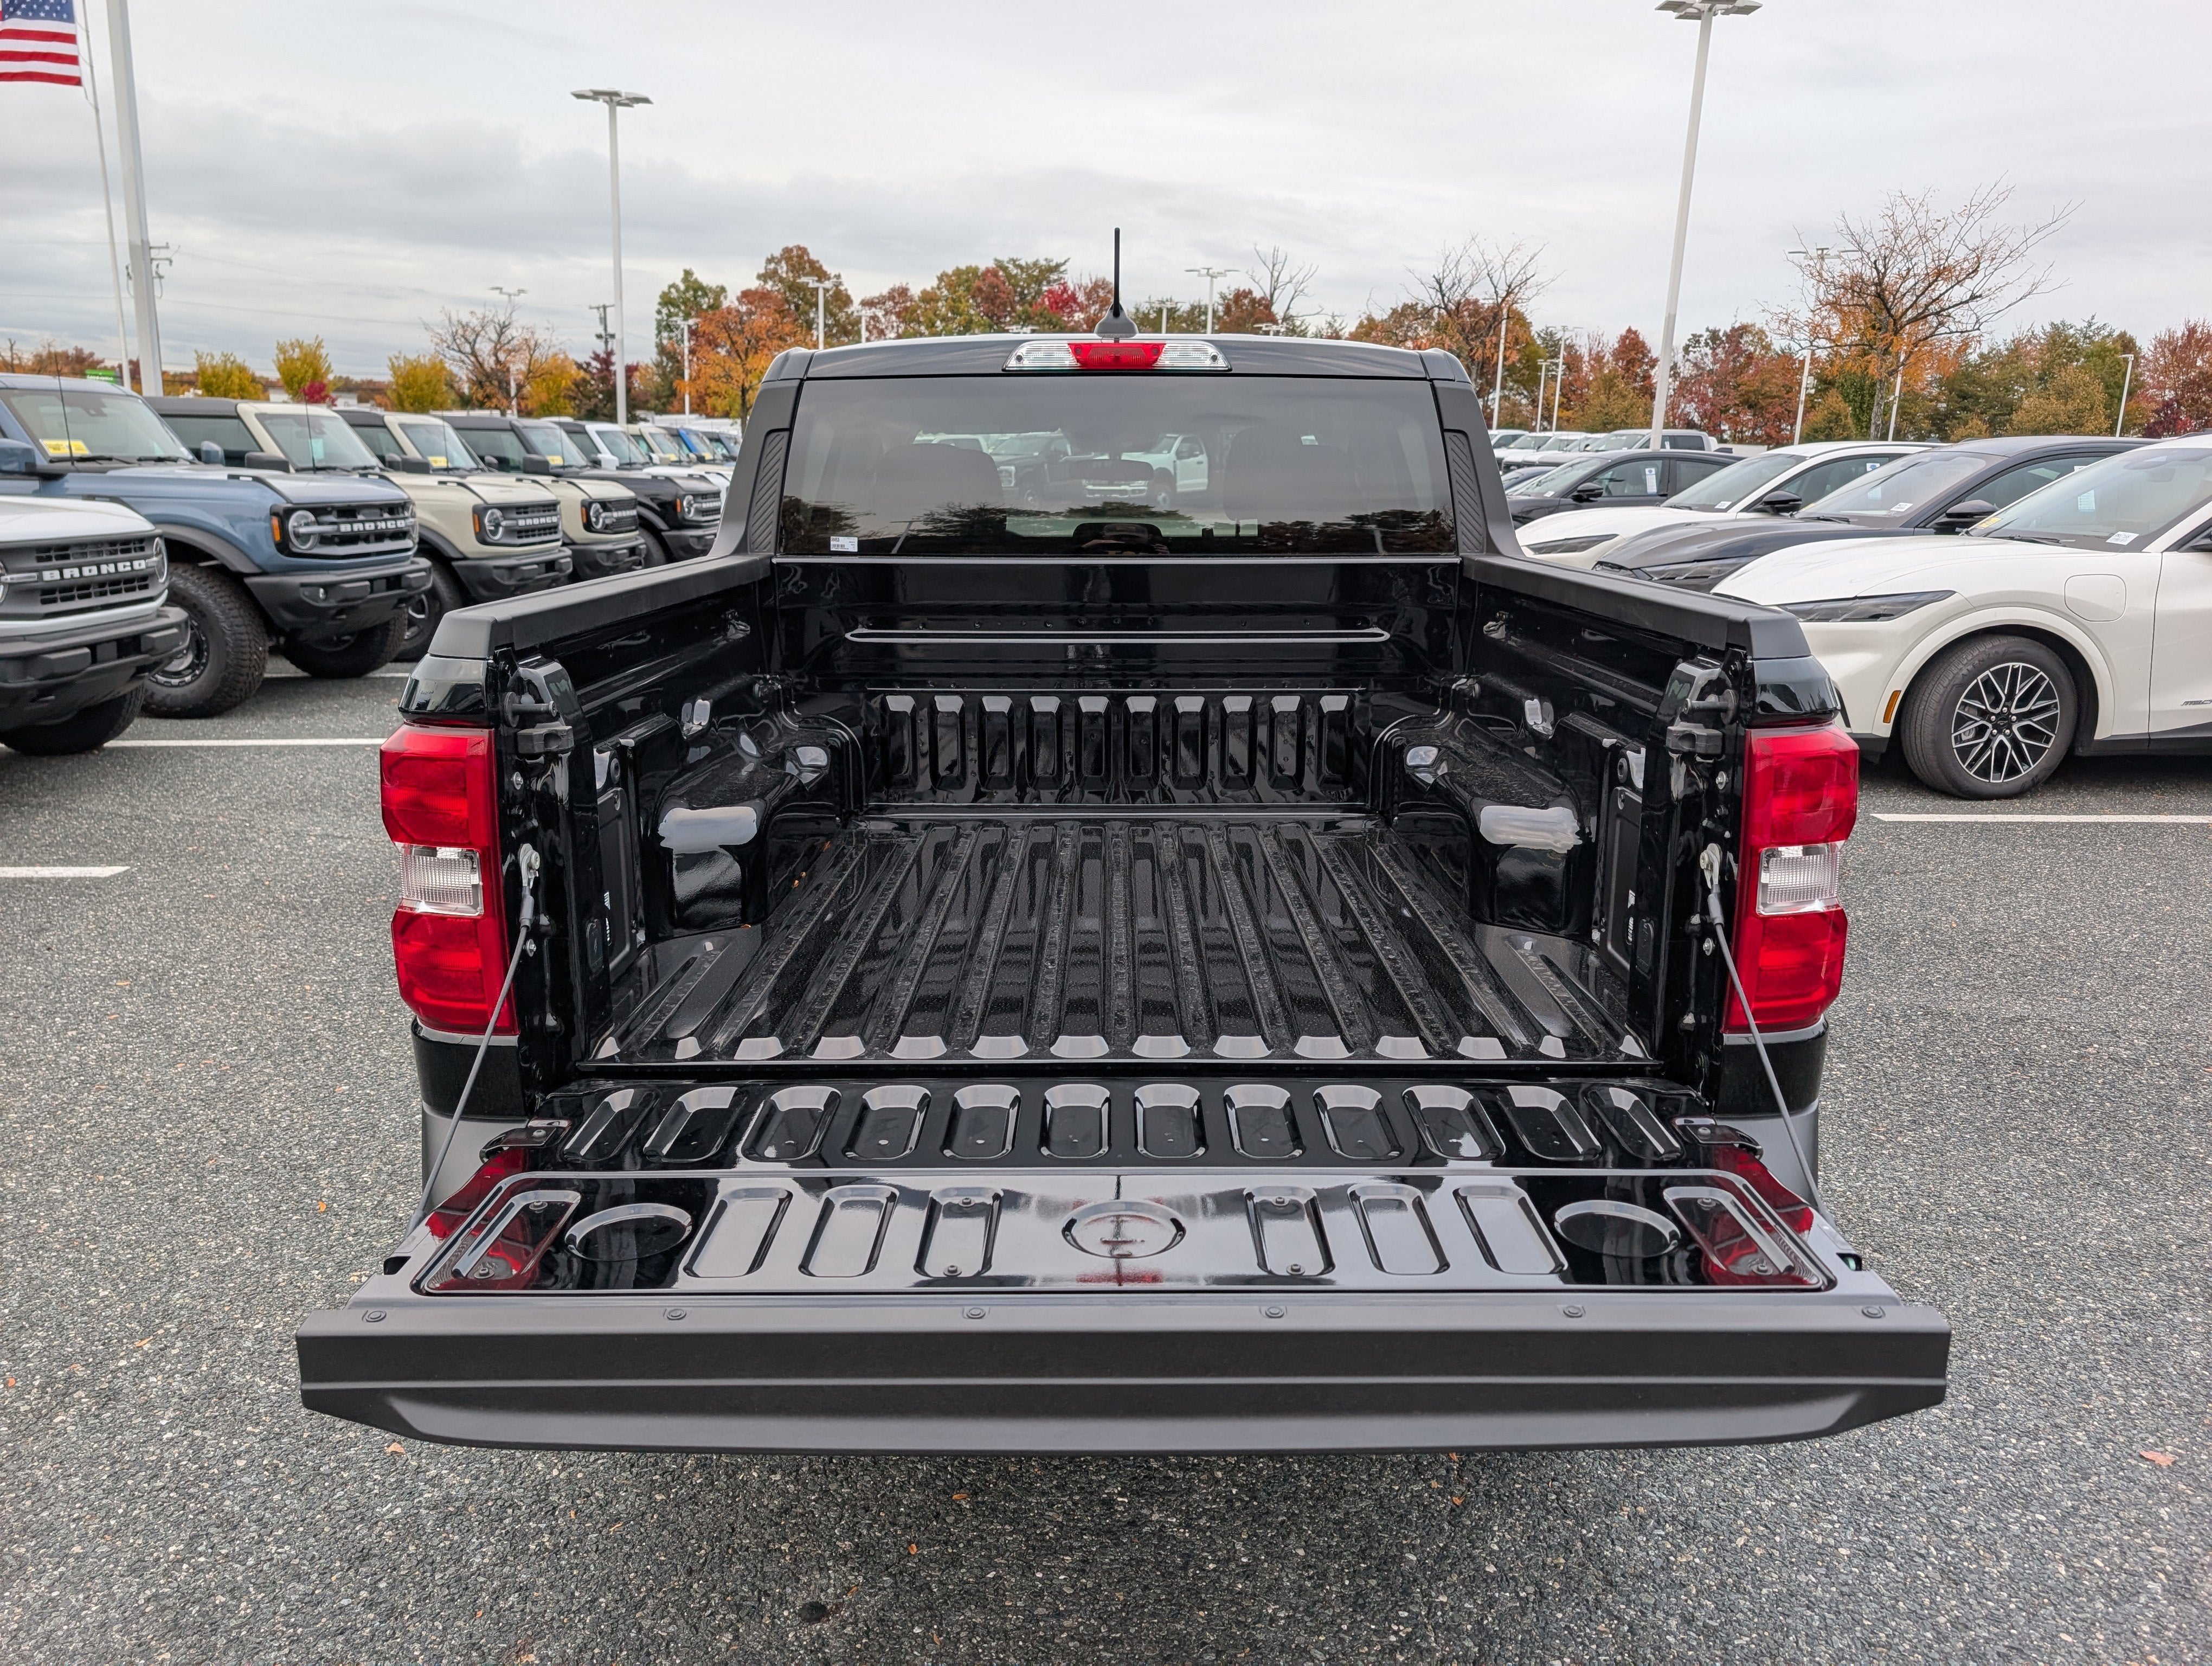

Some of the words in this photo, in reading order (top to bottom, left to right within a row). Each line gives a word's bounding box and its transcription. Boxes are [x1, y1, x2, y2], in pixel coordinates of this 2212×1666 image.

[339, 520, 405, 532] BRONCO
[518, 516, 557, 526] BRONCO
[42, 559, 146, 581] BRONCO
